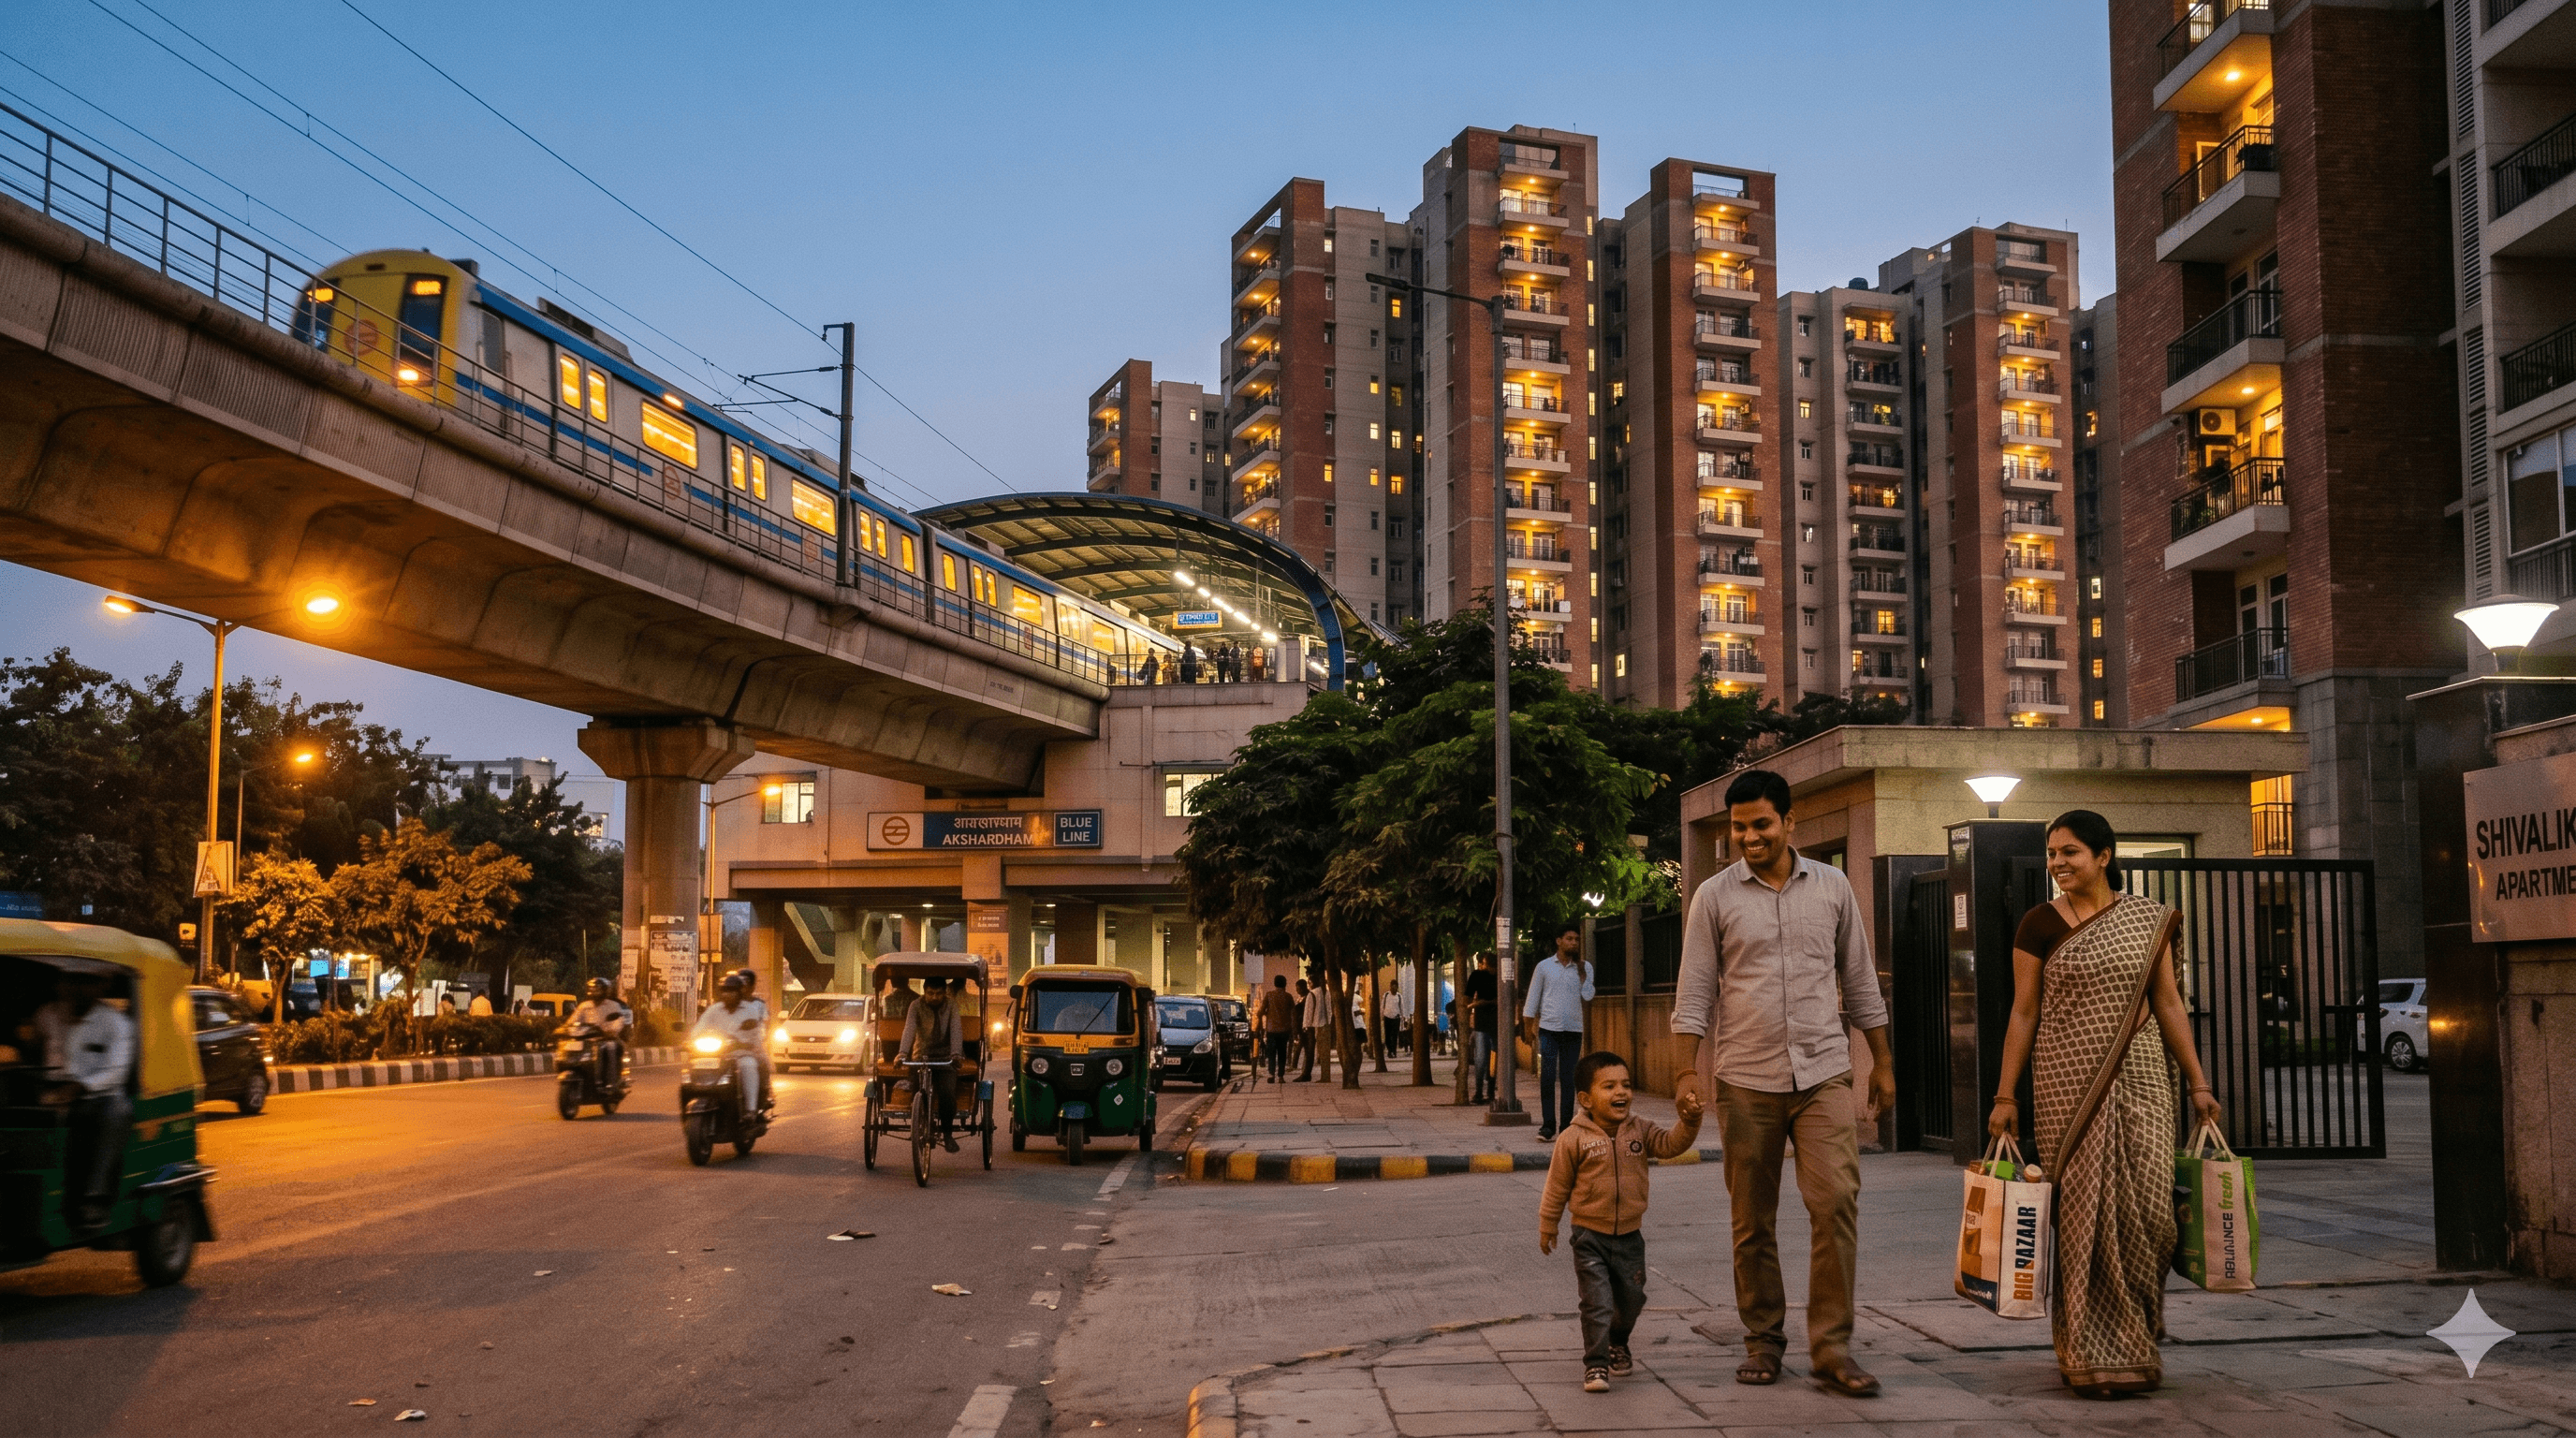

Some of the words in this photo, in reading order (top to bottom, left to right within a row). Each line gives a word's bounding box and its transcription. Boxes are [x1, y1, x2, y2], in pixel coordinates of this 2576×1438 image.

[1060, 817, 1092, 828] BLUE
[1062, 831, 1090, 842] LINE
[2476, 807, 2576, 859] SHIVALIK
[943, 833, 1033, 845] AKSHARDHAM
[2496, 864, 2576, 901] APARTME
[2014, 1206, 2036, 1270] BAZAAR
[2013, 1272, 2034, 1300] BIG
